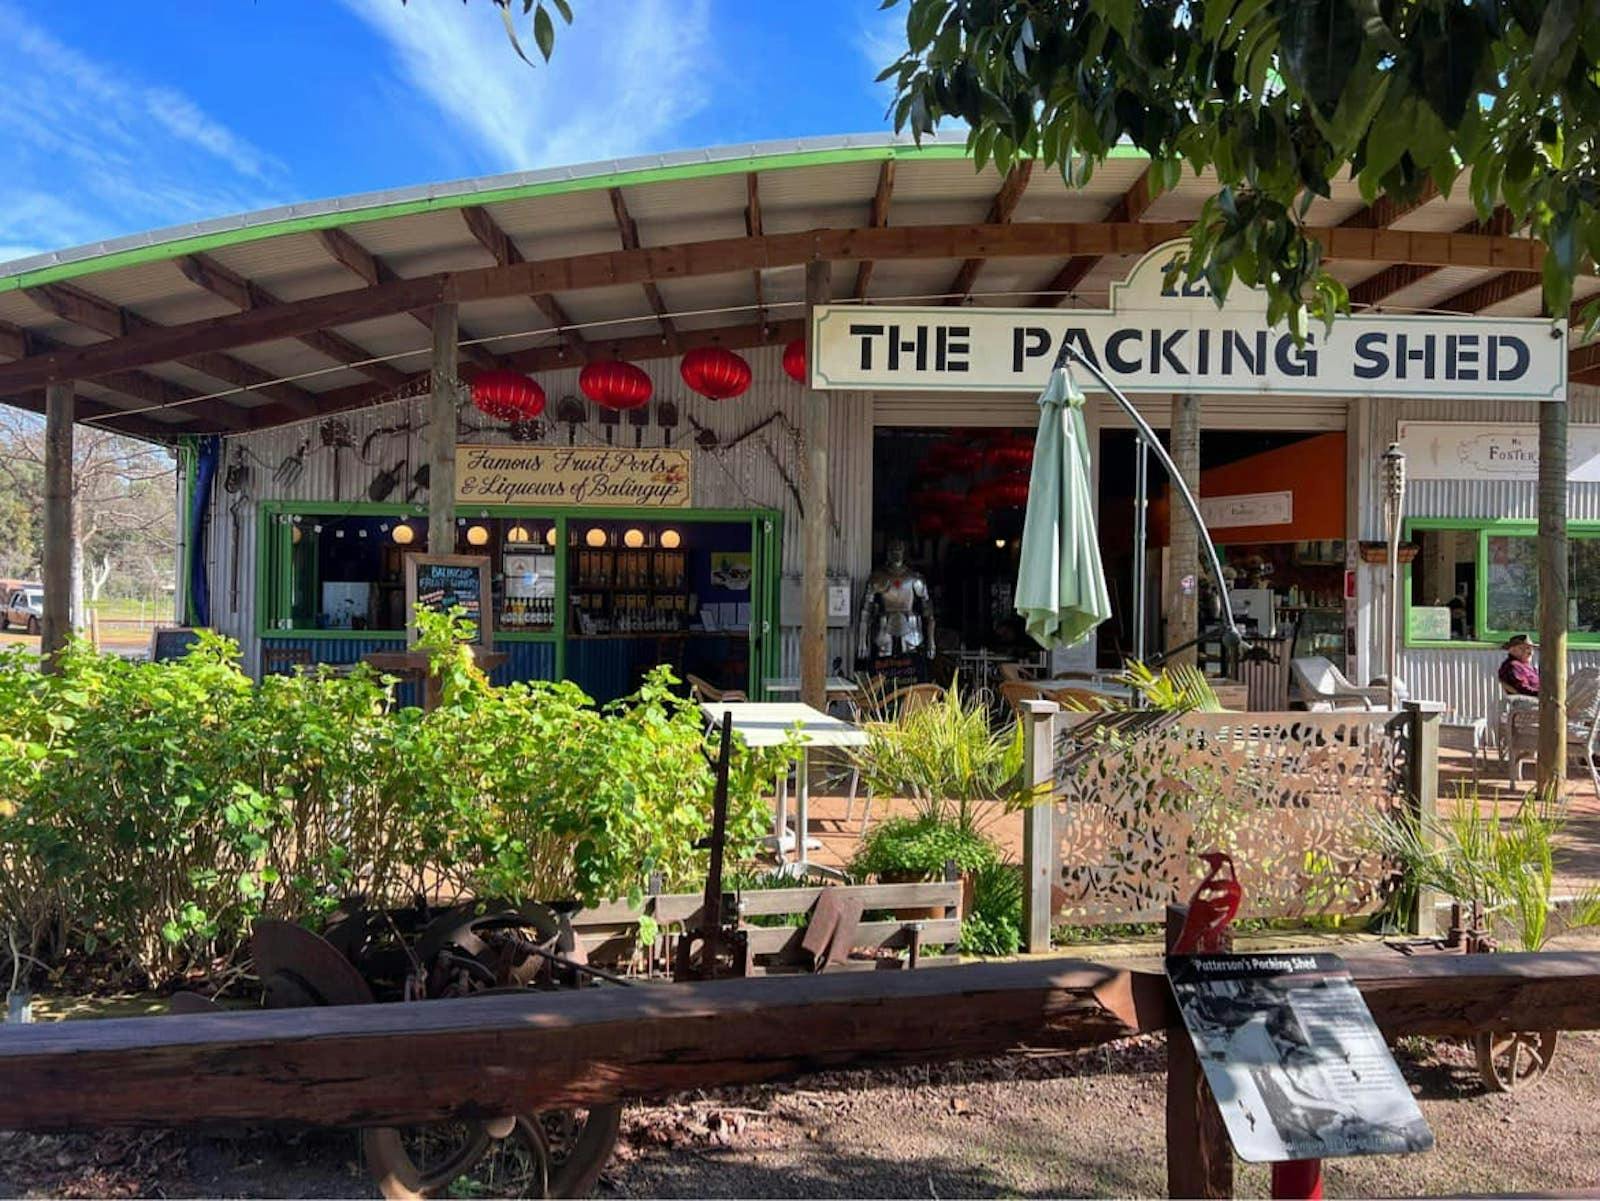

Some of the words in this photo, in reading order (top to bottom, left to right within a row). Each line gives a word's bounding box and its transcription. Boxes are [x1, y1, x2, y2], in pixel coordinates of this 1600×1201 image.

[850, 324, 970, 372] THE
[1013, 327, 1318, 377] PACKING
[1354, 332, 1530, 381] SHED
[467, 450, 542, 471] Famous
[553, 451, 609, 472] Fruit
[609, 451, 671, 472] Ports
[461, 476, 480, 495] &
[478, 473, 565, 504] Liqueurs
[569, 477, 588, 502] of
[588, 473, 680, 504] Balingup
[1251, 957, 1293, 973] Packing
[1291, 957, 1318, 969] Shed
